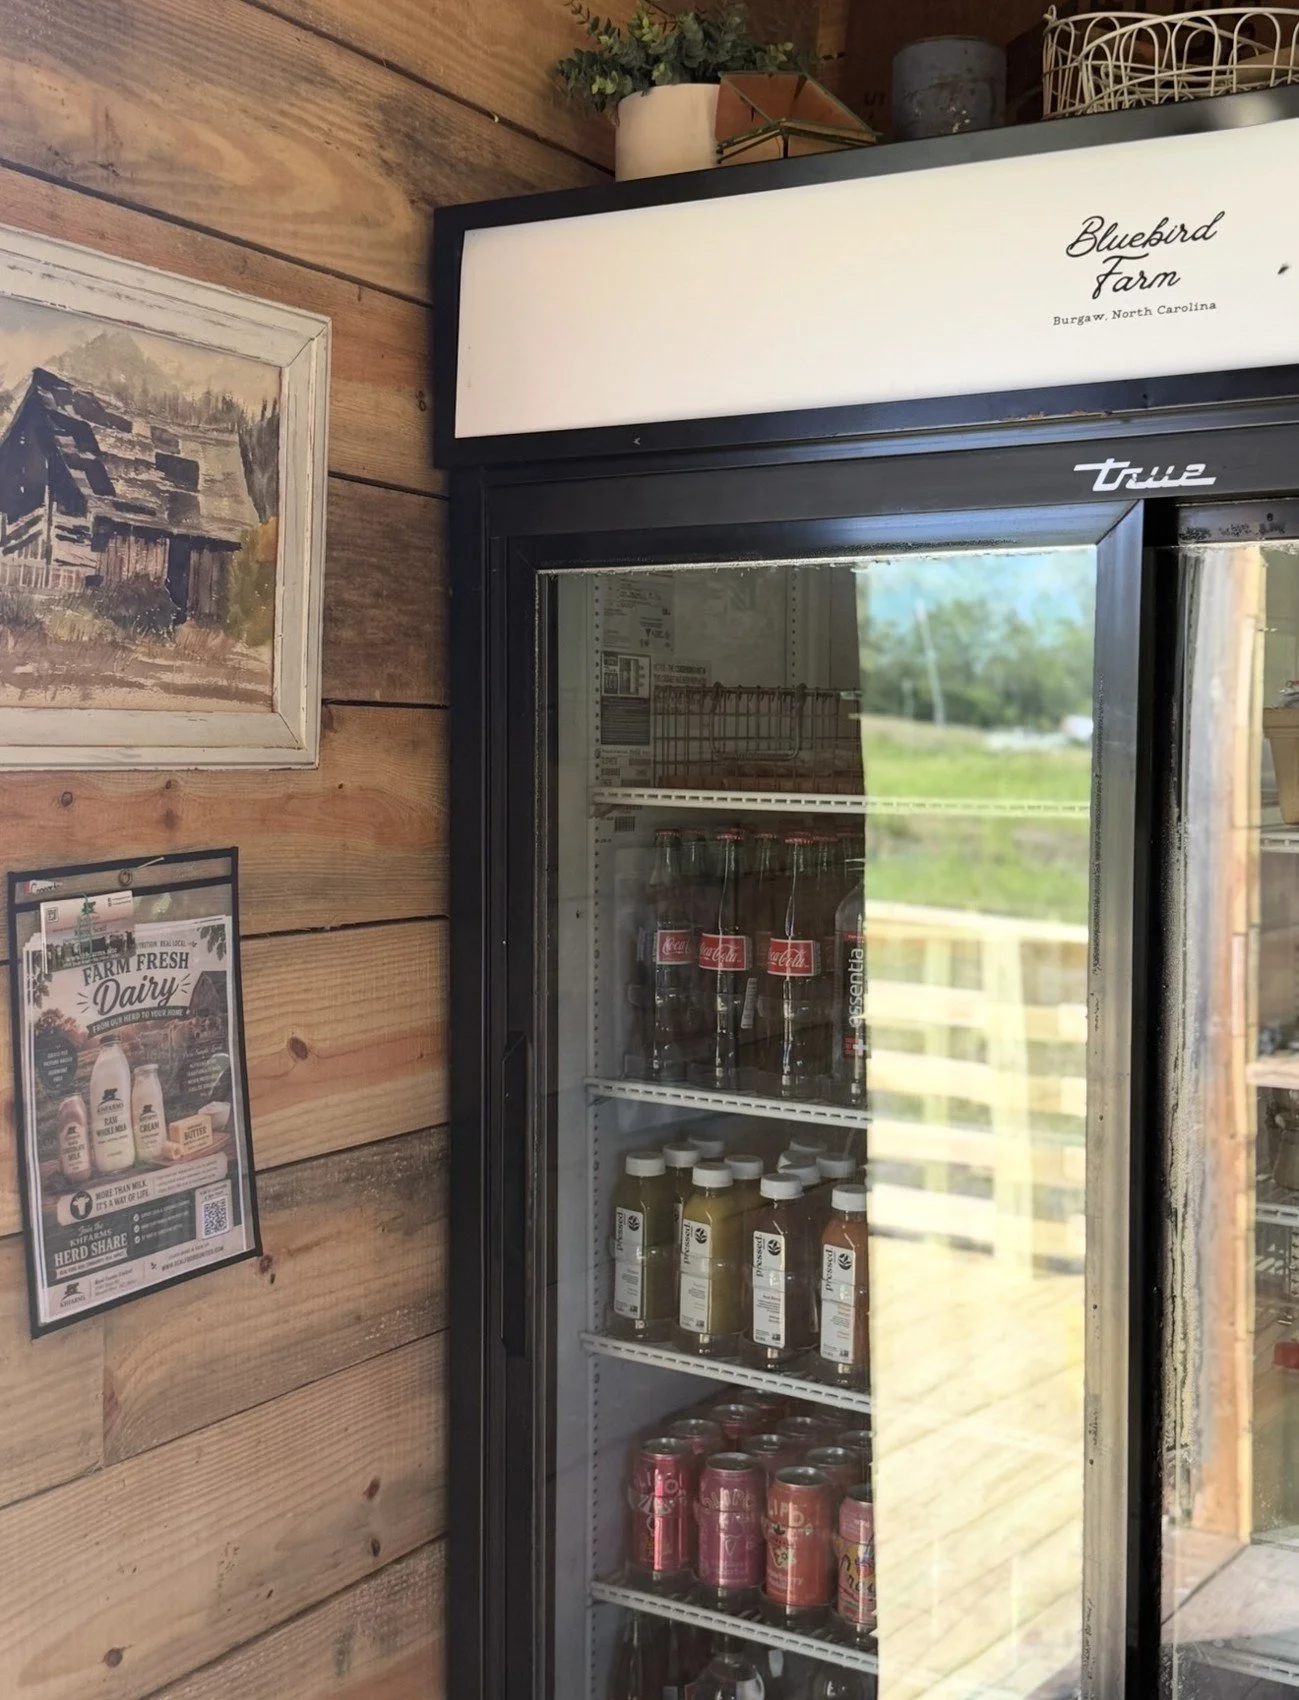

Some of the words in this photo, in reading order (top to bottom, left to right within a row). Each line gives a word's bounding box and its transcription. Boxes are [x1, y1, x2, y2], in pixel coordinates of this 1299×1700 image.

[1065, 210, 1225, 258] Bluebird
[1091, 252, 1181, 300] Farm
[1052, 311, 1109, 326] Burgaw,
[1111, 307, 1153, 320] North
[1156, 301, 1217, 316] Carolina
[83, 957, 132, 987] FARM
[136, 951, 190, 972] FRESH
[93, 975, 180, 1016] Dairy
[848, 947, 864, 1028] essentia
[92, 1021, 110, 1033] FROM
[110, 1017, 122, 1027] OUR
[123, 1013, 140, 1023] HERD
[142, 1011, 150, 1019] TO
[151, 1009, 166, 1017] YOUR
[168, 1008, 183, 1017] HOME
[184, 1126, 208, 1140] BUTTER
[95, 1189, 114, 1200] MORE
[114, 1184, 132, 1195] THAN
[96, 1201, 109, 1212] IT'S
[108, 1199, 114, 1208] A
[114, 1194, 128, 1205] WAY
[128, 1192, 136, 1202] OF
[54, 1245, 88, 1267] HERD
[91, 1232, 128, 1256] SHARE
